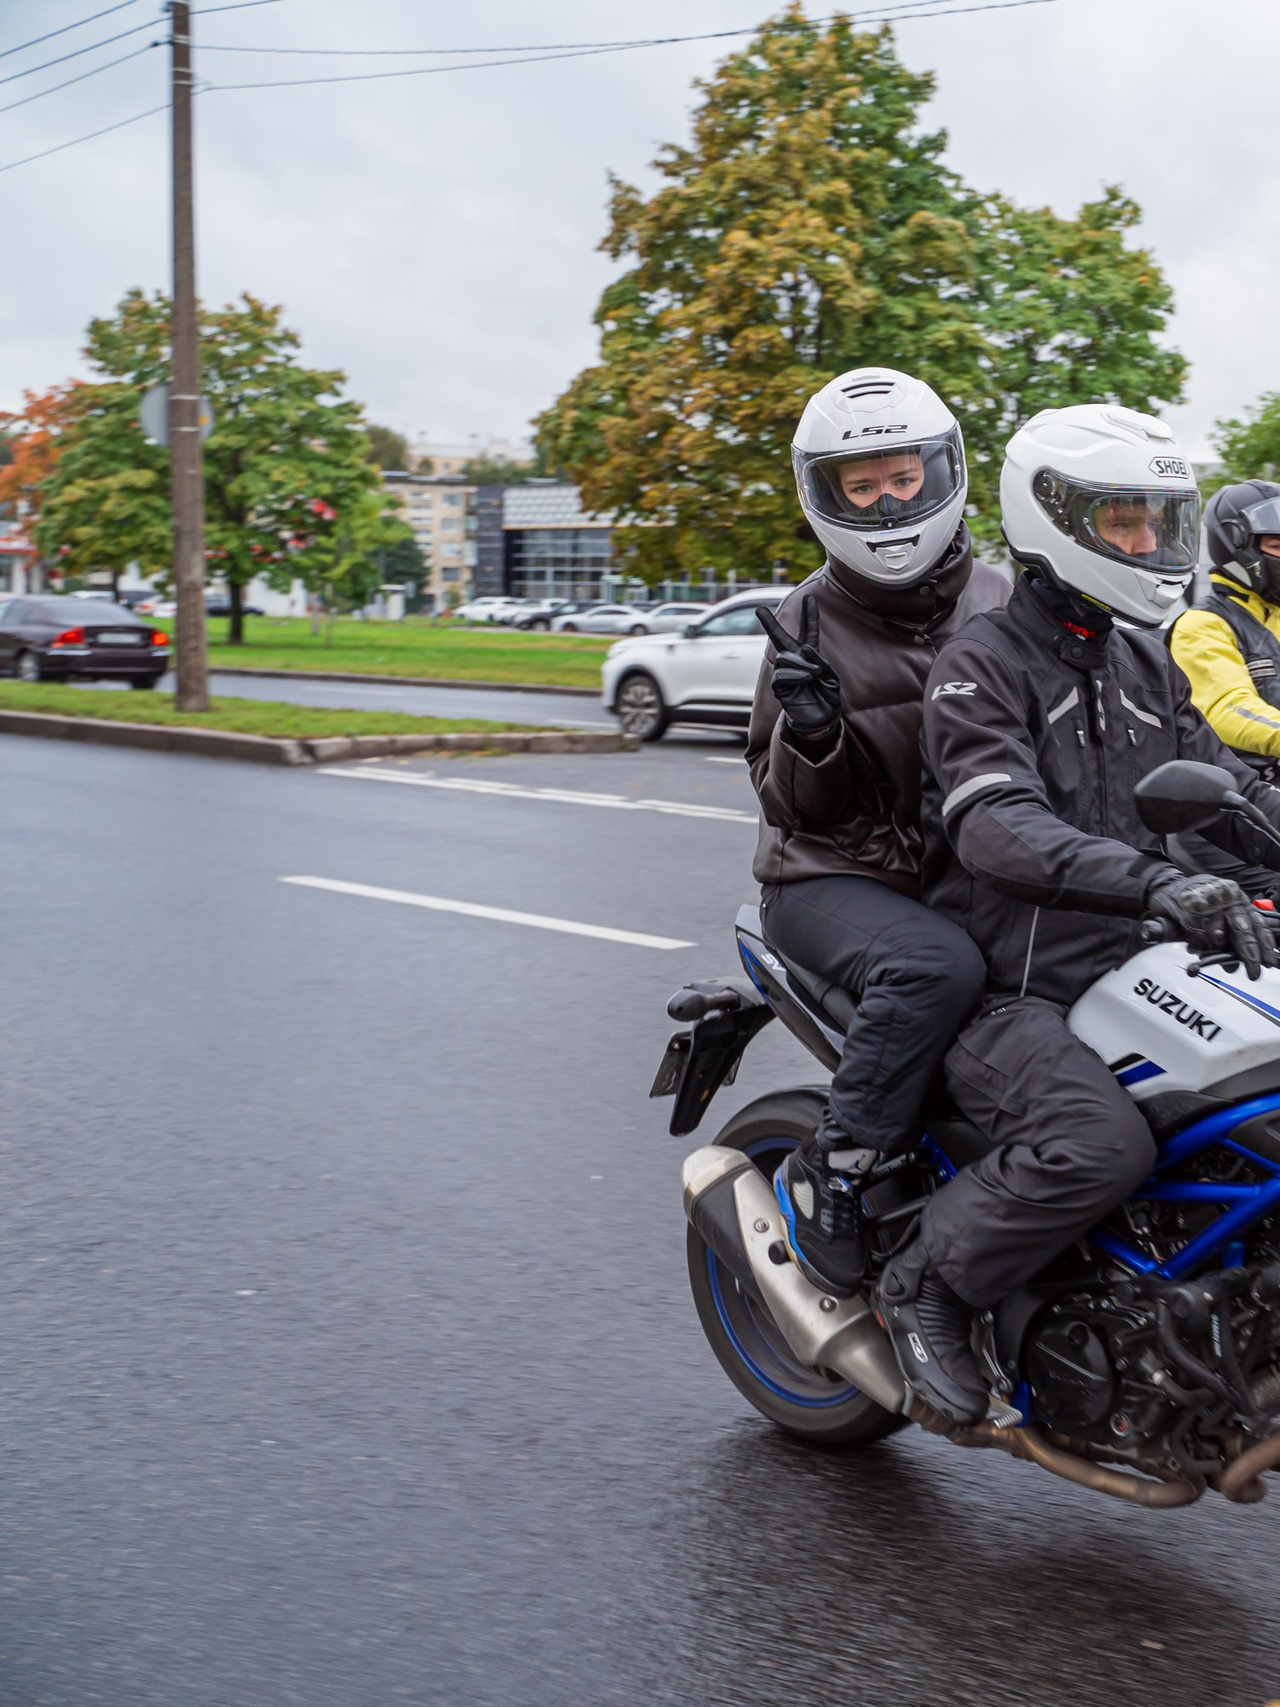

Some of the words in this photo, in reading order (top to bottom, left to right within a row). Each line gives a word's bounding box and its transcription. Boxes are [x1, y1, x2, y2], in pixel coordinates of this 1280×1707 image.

[842, 424, 908, 441] LS2
[931, 681, 978, 701] LS2
[1133, 978, 1223, 1043] SUZUKI
